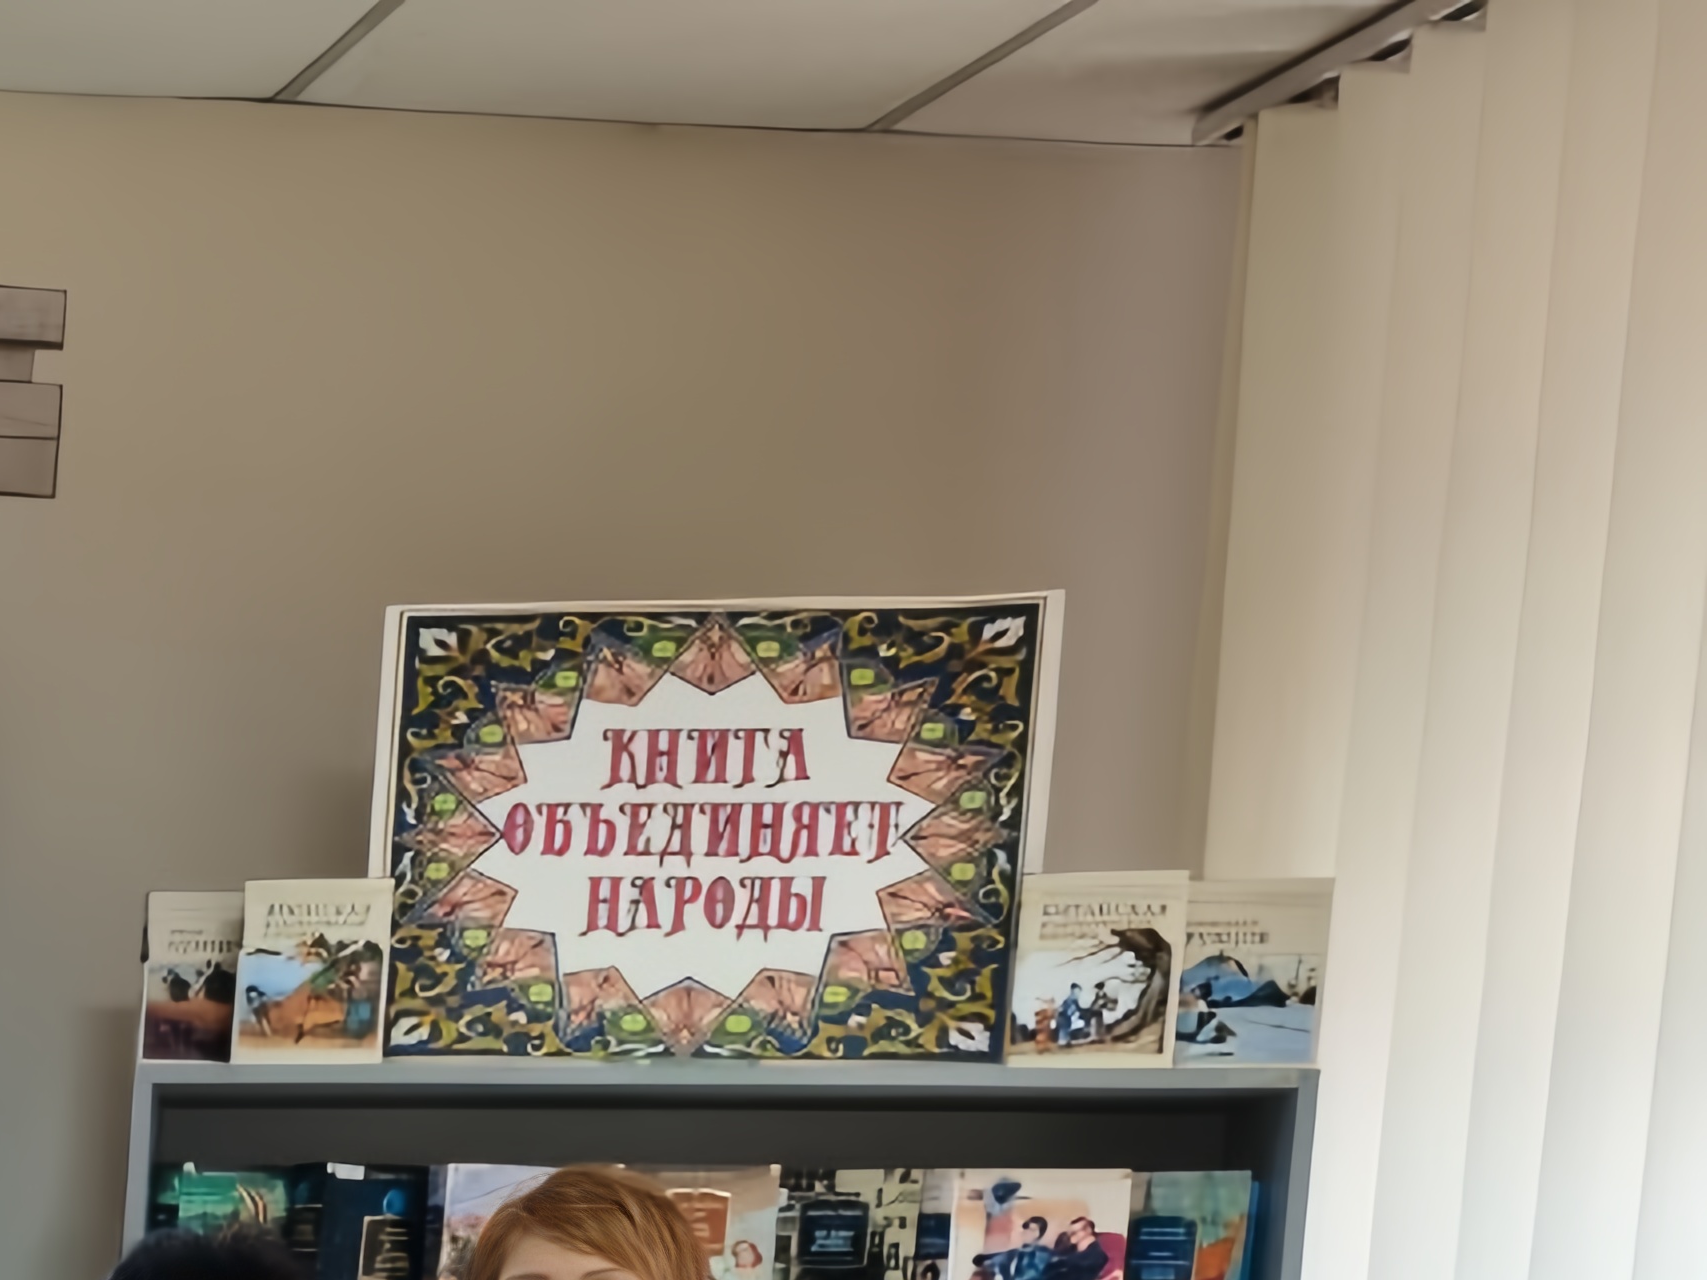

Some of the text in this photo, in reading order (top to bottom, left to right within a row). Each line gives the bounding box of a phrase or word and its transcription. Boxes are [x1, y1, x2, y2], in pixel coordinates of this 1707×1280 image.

[600, 727, 811, 790] КНИГА
[503, 801, 905, 867] ОБЪЕДИНЯЕТ
[579, 876, 827, 943] НАРОДЫ
